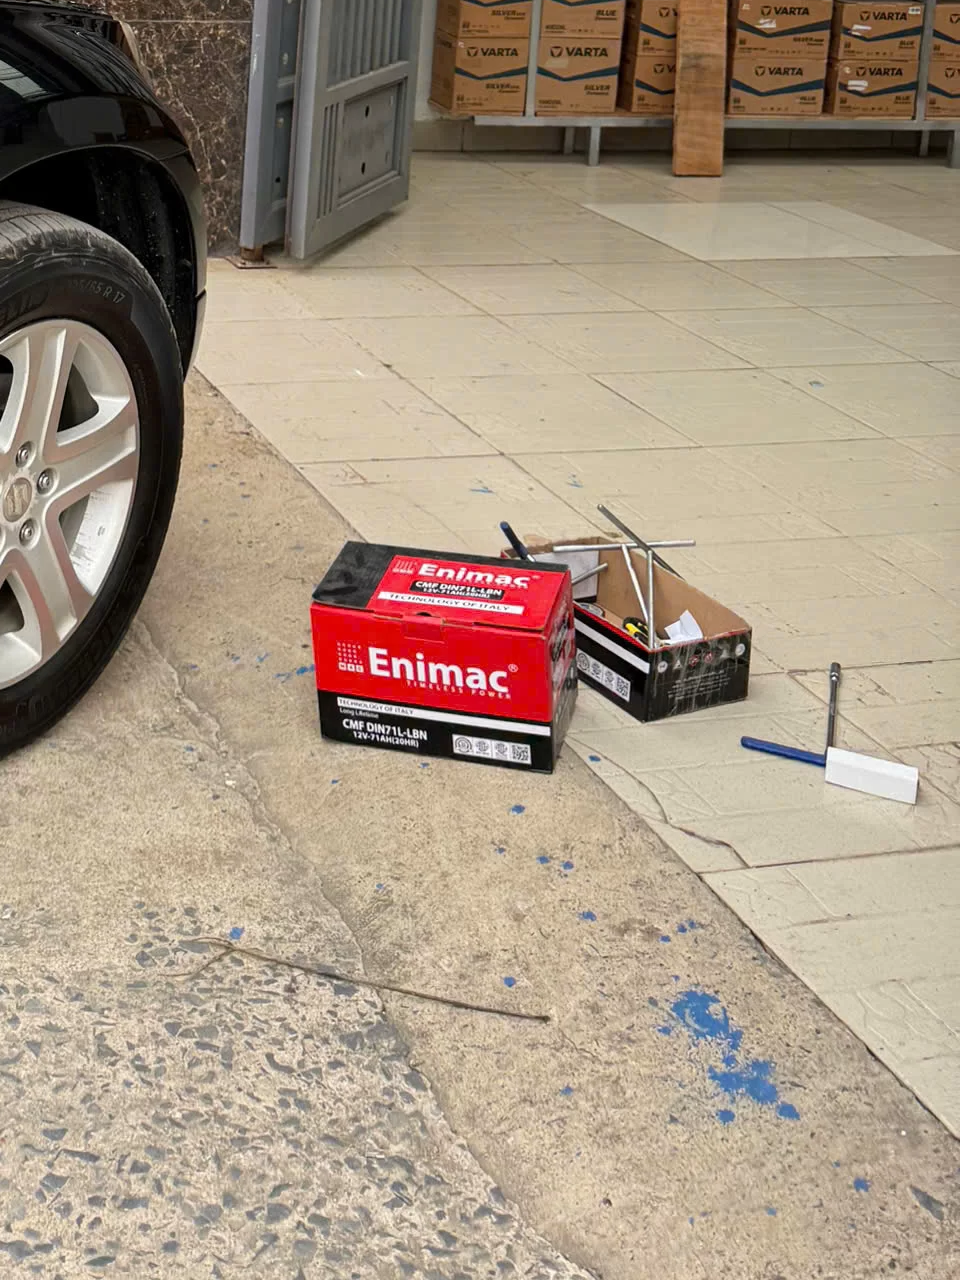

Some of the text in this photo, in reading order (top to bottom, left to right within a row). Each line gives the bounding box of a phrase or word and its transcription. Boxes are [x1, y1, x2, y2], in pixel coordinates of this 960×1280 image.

[774, 6, 810, 16] VARTA
[873, 11, 907, 21] VARTA
[481, 47, 519, 57] VARTA
[566, 46, 608, 58] VARTA
[768, 67, 803, 77] VARTA
[869, 67, 903, 77] VARTA
[584, 84, 610, 92] SILVER
[113, 291, 126, 304] 17
[418, 563, 531, 588] Enimac
[415, 580, 439, 589] CMF
[439, 583, 502, 596] DIN71L-LBN
[390, 593, 460, 606] TECHNOLOGY
[480, 602, 511, 611] ITALY
[367, 646, 509, 694] Enimac
[406, 679, 512, 700] TIMELESS POWER
[339, 699, 414, 715] TECHNOLOGY OF ITALY
[340, 708, 354, 717] Long
[342, 719, 428, 741] CMF DIN71L-LBN
[353, 730, 420, 749] 12V-71AH(20HR)
